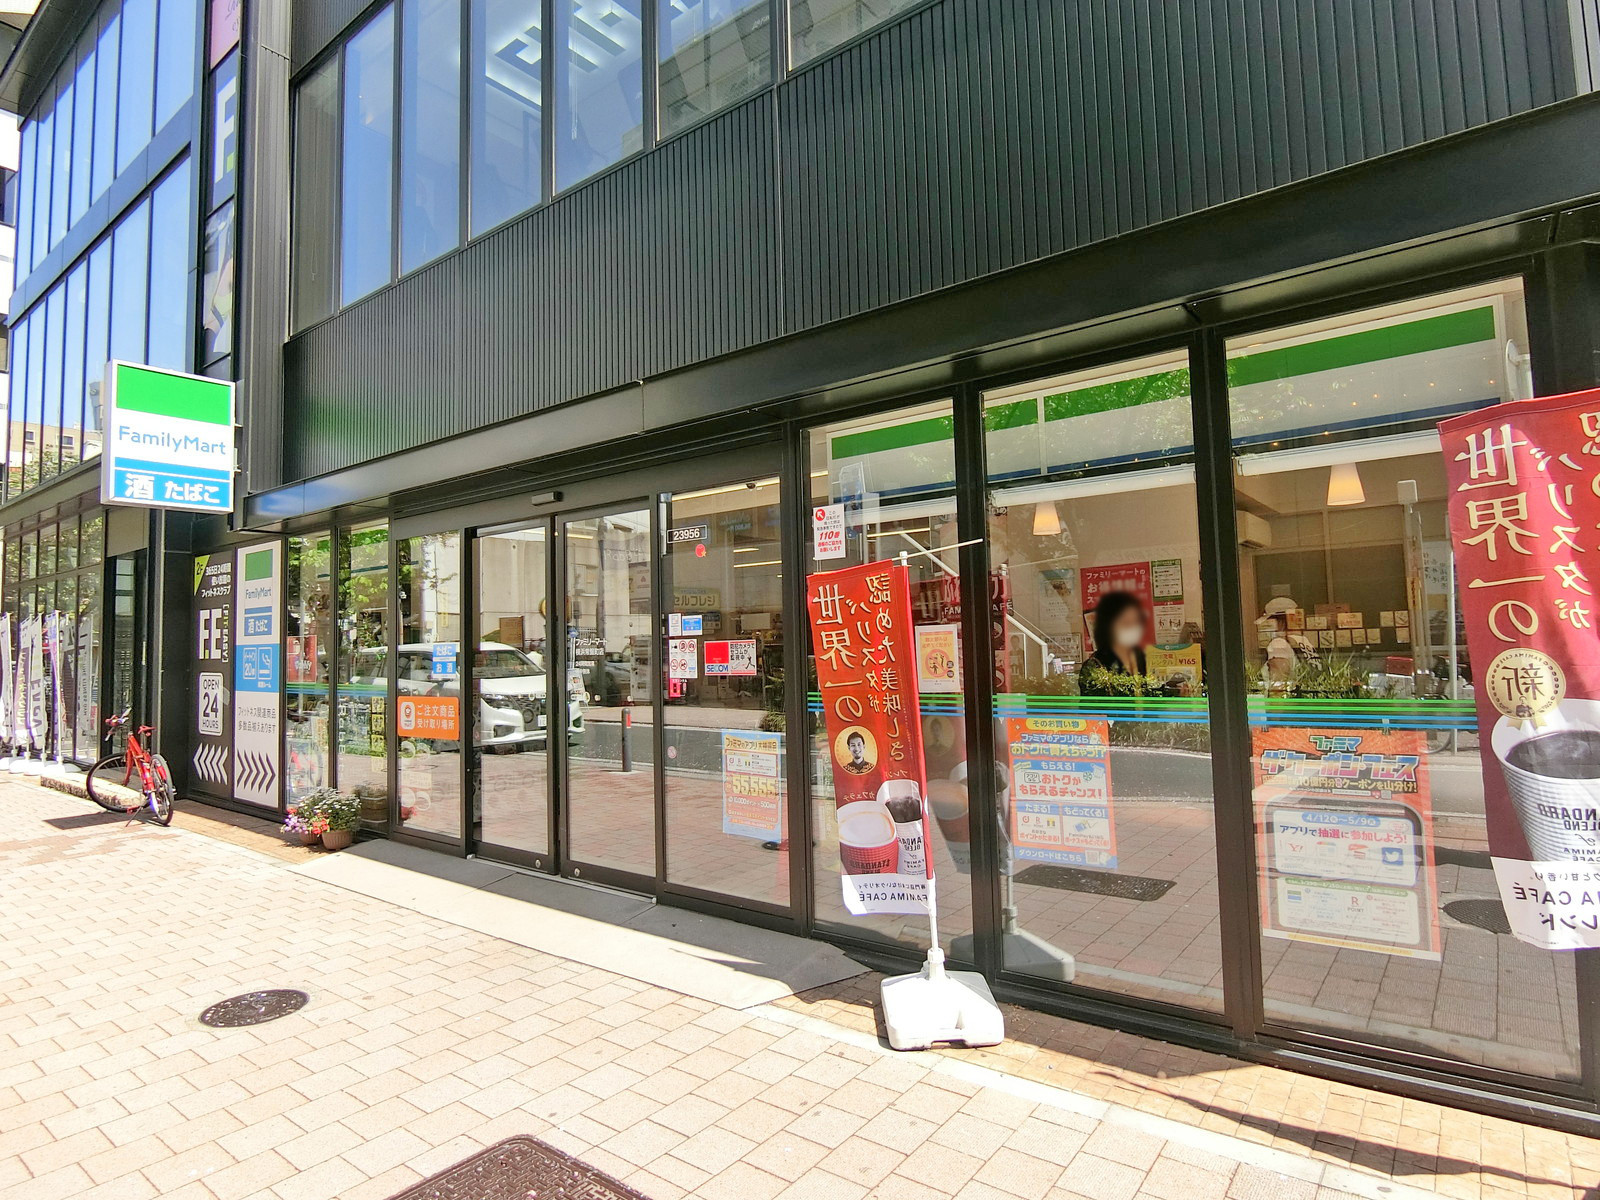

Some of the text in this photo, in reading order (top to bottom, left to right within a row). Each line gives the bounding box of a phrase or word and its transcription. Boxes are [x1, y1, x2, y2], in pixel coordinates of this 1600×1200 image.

[119, 425, 226, 455] FamilyMart
[125, 473, 220, 503] 酒 たばこ
[673, 529, 700, 540] 23956
[1086, 567, 1146, 580] ファミリーマートの
[201, 585, 231, 598] フィットネスクラブ
[246, 586, 272, 600] FamilyMart
[248, 619, 255, 634] 酒
[575, 637, 608, 647] ファミリーマート
[730, 643, 756, 651] 防犯カメラで
[436, 645, 453, 656] たばこ
[706, 664, 729, 673] SECOM
[203, 679, 220, 690] OPEN
[203, 692, 219, 718] 24
[417, 704, 456, 718] ご注文商品
[203, 719, 219, 729] HOURS
[417, 718, 456, 730] 受け取り場所
[1033, 720, 1080, 728] そのお買い物
[1021, 734, 1089, 744] ファミマのアプリなら
[1310, 736, 1363, 751] ファミマ
[1011, 743, 1106, 758] おトクに買えちゃう!?
[1041, 761, 1076, 771] もらえる!
[1041, 774, 1081, 786] おトクが
[1019, 785, 1102, 799] もらえるチャンス!
[1025, 803, 1106, 817] たまる! もどってくる!
[1279, 825, 1408, 844] アプリで抽選に参加しよう!
[1019, 849, 1082, 862] ダウンロードはこちら
